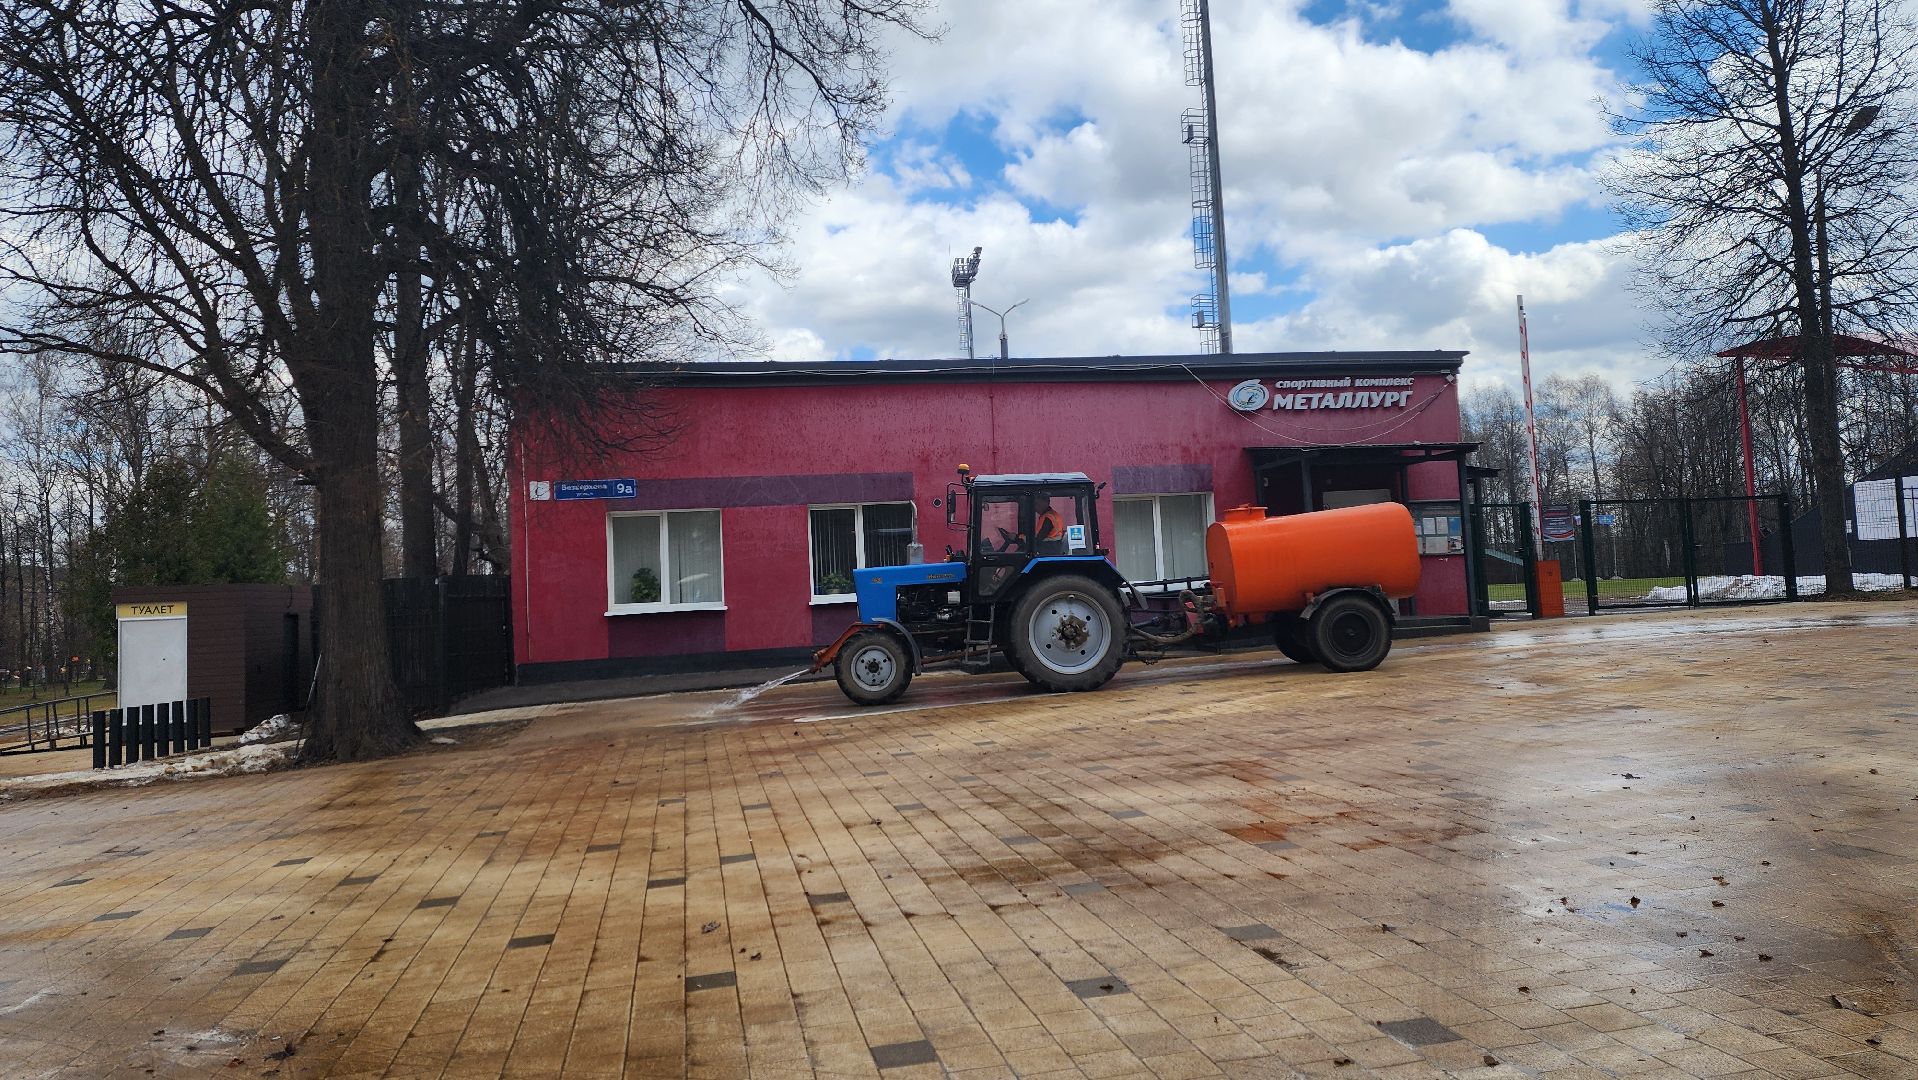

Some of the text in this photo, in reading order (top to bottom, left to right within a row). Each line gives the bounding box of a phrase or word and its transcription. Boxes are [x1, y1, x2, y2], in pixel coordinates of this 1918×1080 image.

[1275, 377, 1415, 390] спортивный комплекс
[1273, 390, 1414, 410] МЕТАЛЛУРГ
[616, 483, 634, 494] 9а
[131, 604, 175, 615] ТУАЛЕТ
